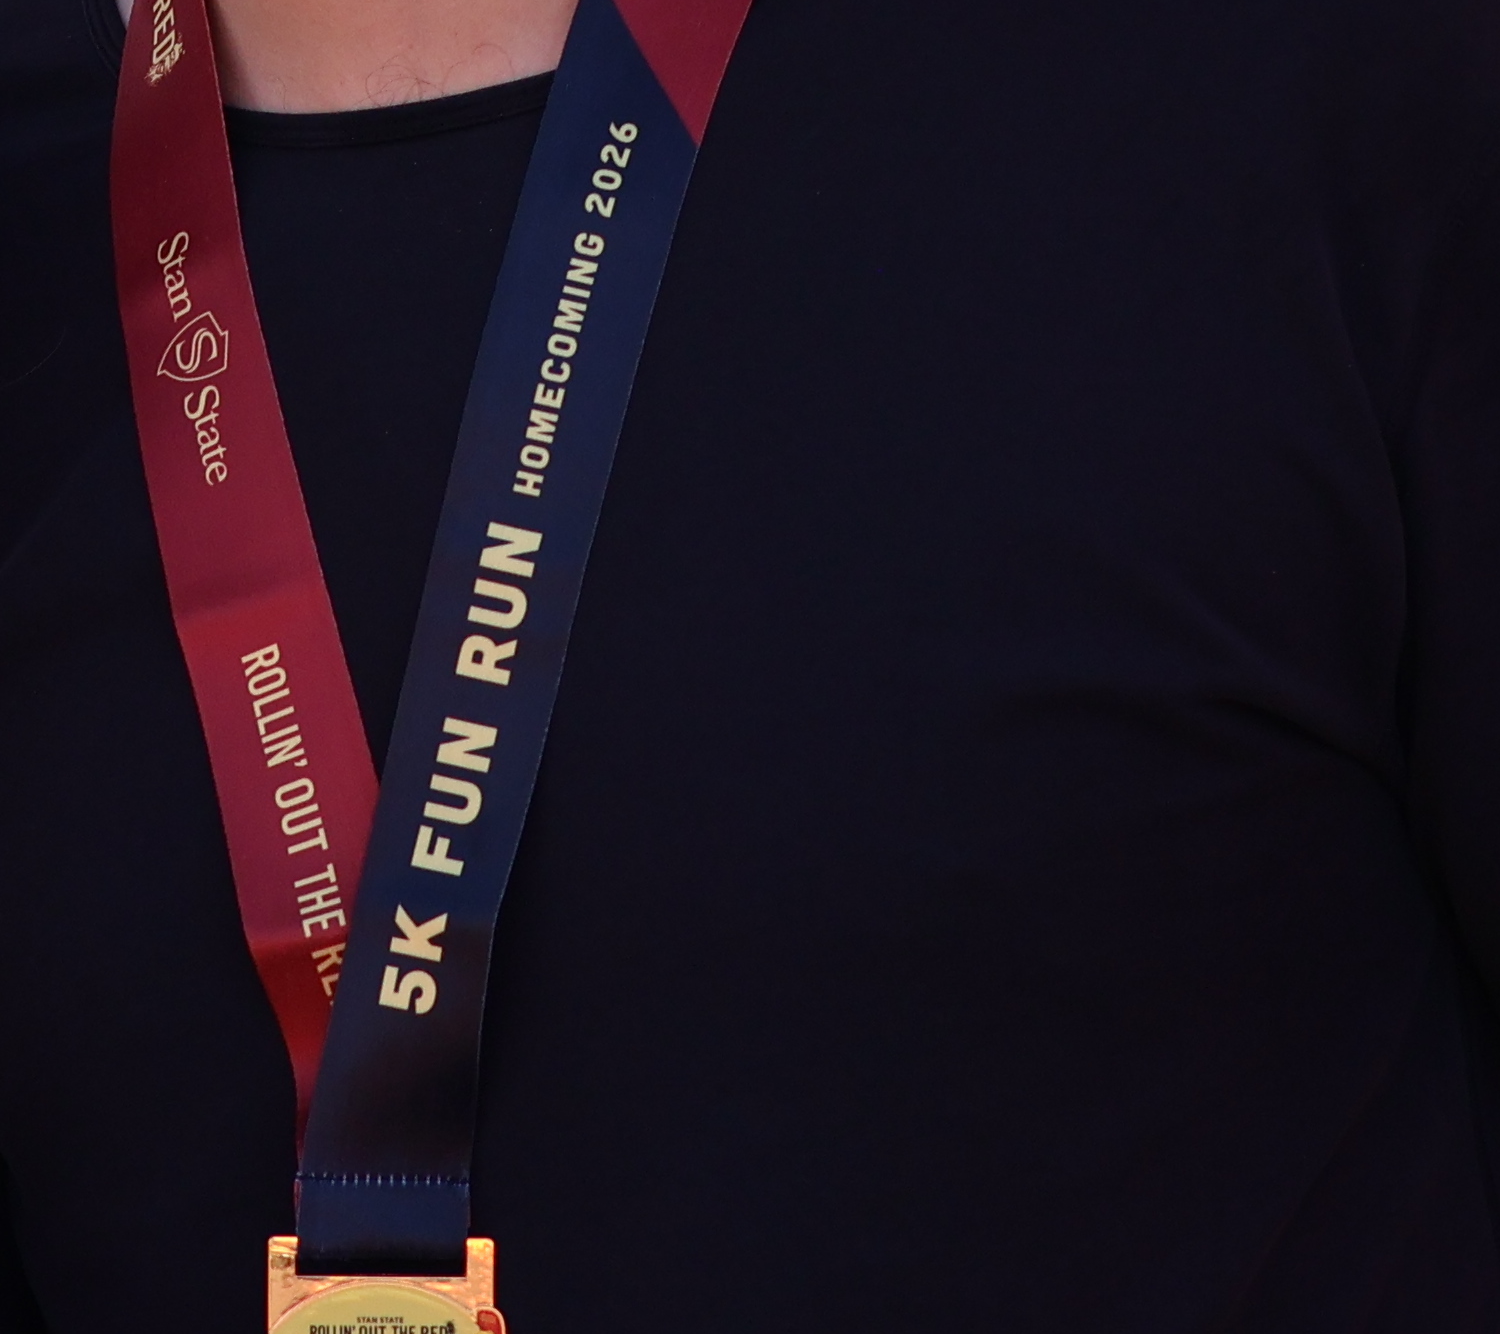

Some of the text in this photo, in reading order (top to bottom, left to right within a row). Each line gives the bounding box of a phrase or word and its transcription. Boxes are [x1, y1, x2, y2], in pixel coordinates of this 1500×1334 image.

[157, 230, 192, 323] Stan
[184, 385, 228, 486] State
[378, 121, 639, 1015] 5K FUN RUN HOMECOMING 2026
[241, 643, 308, 768] ROLLIN'
[274, 777, 329, 855] OUT
[294, 863, 347, 939] THE
[357, 1316, 404, 1324] STAN STATE
